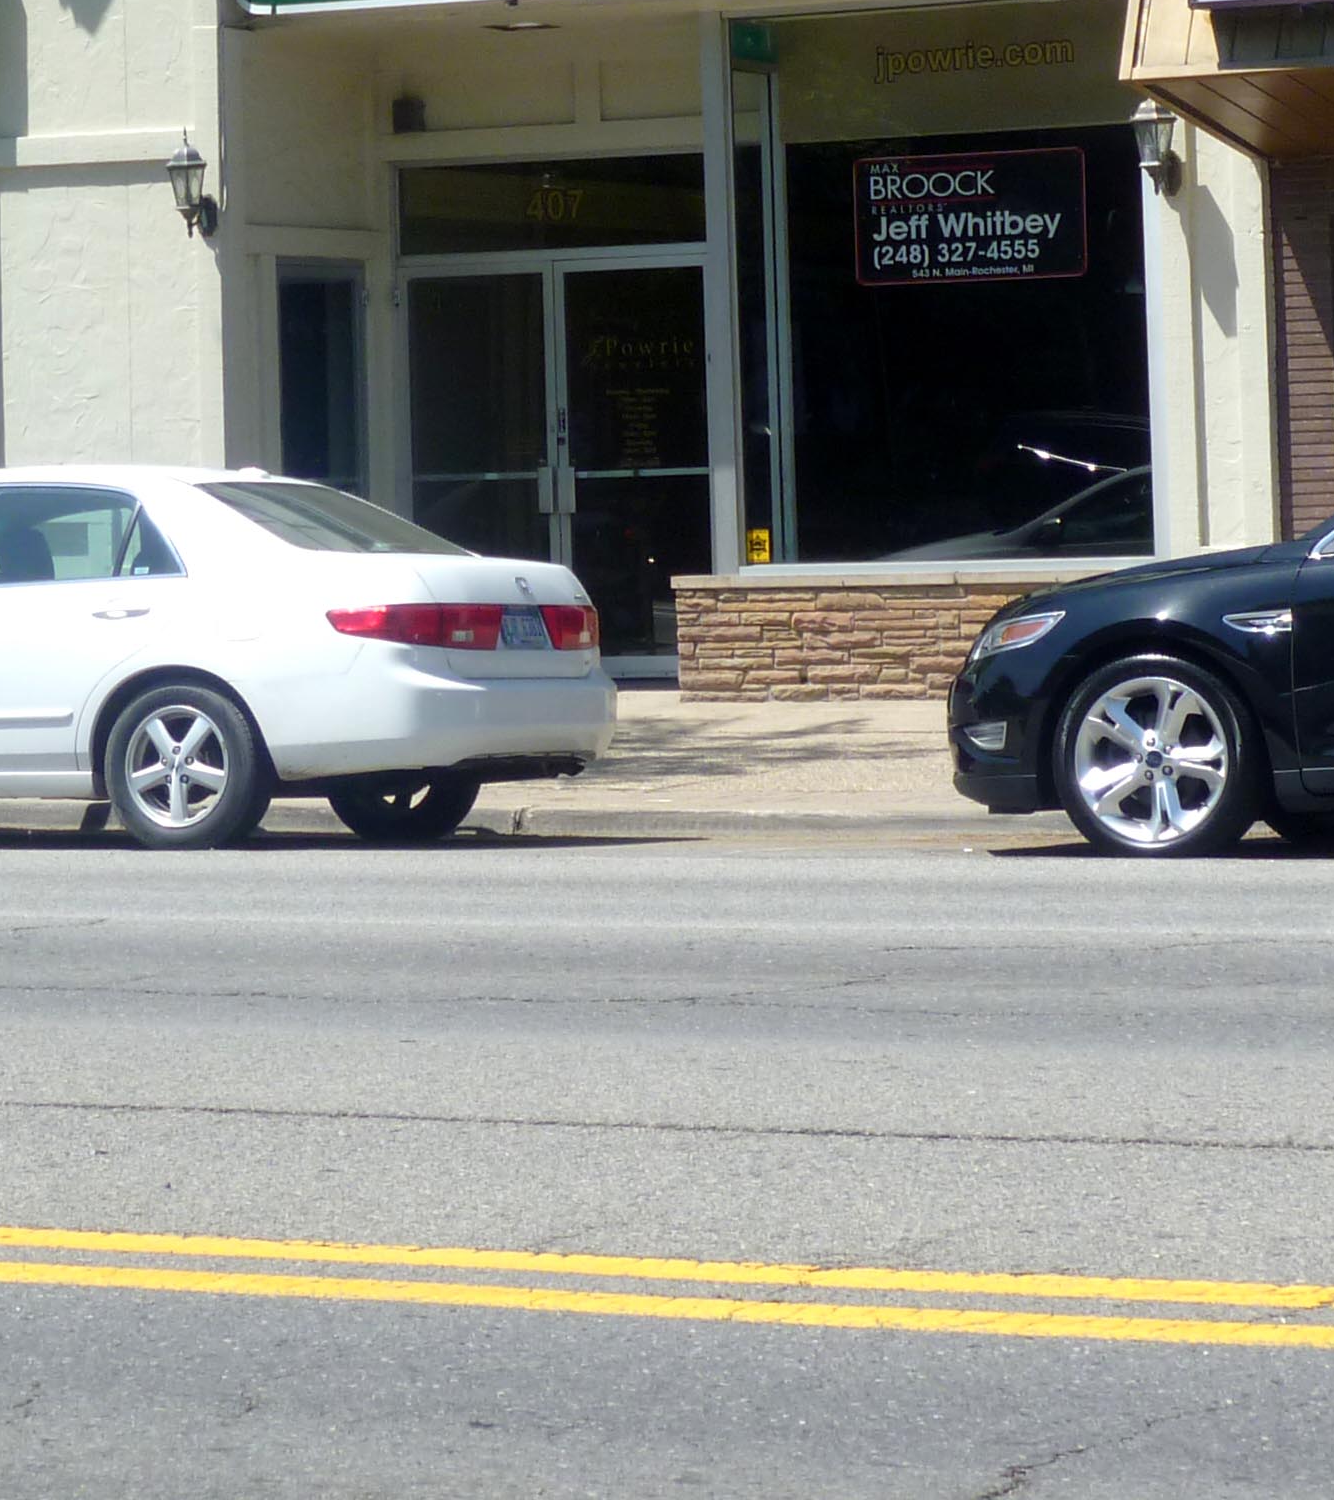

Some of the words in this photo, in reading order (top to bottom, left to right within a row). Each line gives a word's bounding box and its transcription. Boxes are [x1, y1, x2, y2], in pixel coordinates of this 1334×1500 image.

[874, 38, 1075, 84] jpowrie.com
[869, 163, 900, 175] MAX
[869, 170, 996, 200] BROOCK
[525, 189, 586, 221] 407
[872, 214, 930, 242] Jeff
[937, 210, 1063, 239] Whitbey
[873, 244, 930, 270] (248)
[937, 239, 1041, 263] 327-4555
